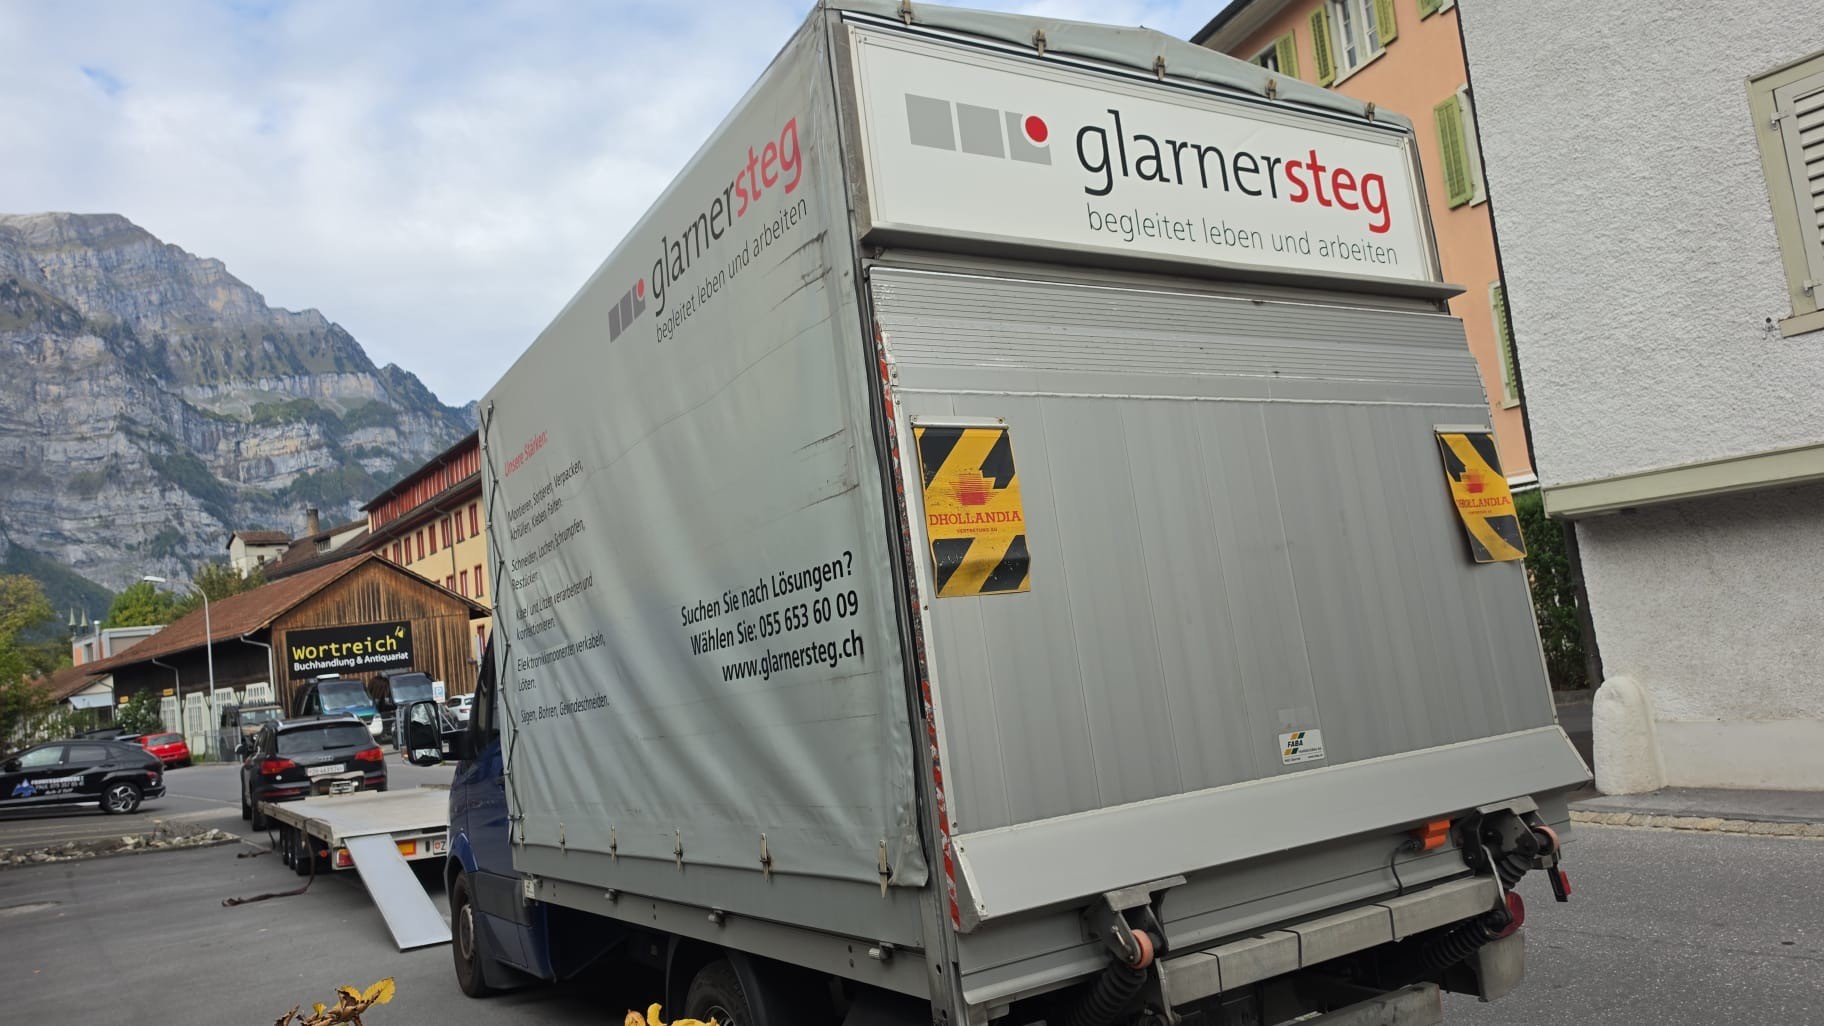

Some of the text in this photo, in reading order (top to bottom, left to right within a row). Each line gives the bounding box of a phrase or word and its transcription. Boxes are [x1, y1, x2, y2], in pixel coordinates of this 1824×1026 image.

[1076, 109, 1393, 234] glarnersteg
[651, 116, 803, 318] glarnersteg
[1087, 203, 1399, 265] begleitet leben und arbeiten
[655, 197, 808, 343] begleitet leben und arbeiten
[504, 453, 524, 478] Unsere
[553, 459, 584, 488] Verpacken,
[928, 511, 1022, 526] DHOLLANDIA
[681, 550, 853, 627] Suchen Sie nach Lösungen?
[690, 590, 859, 656] Wählen Sie: 055 653 60 09
[293, 651, 409, 672] Buchhandlung & Antiquariat
[722, 629, 865, 682] www.glarnersteg.ch
[518, 678, 537, 692] Löten.
[538, 704, 558, 719] Bohren,
[1287, 740, 1303, 748] FABA
